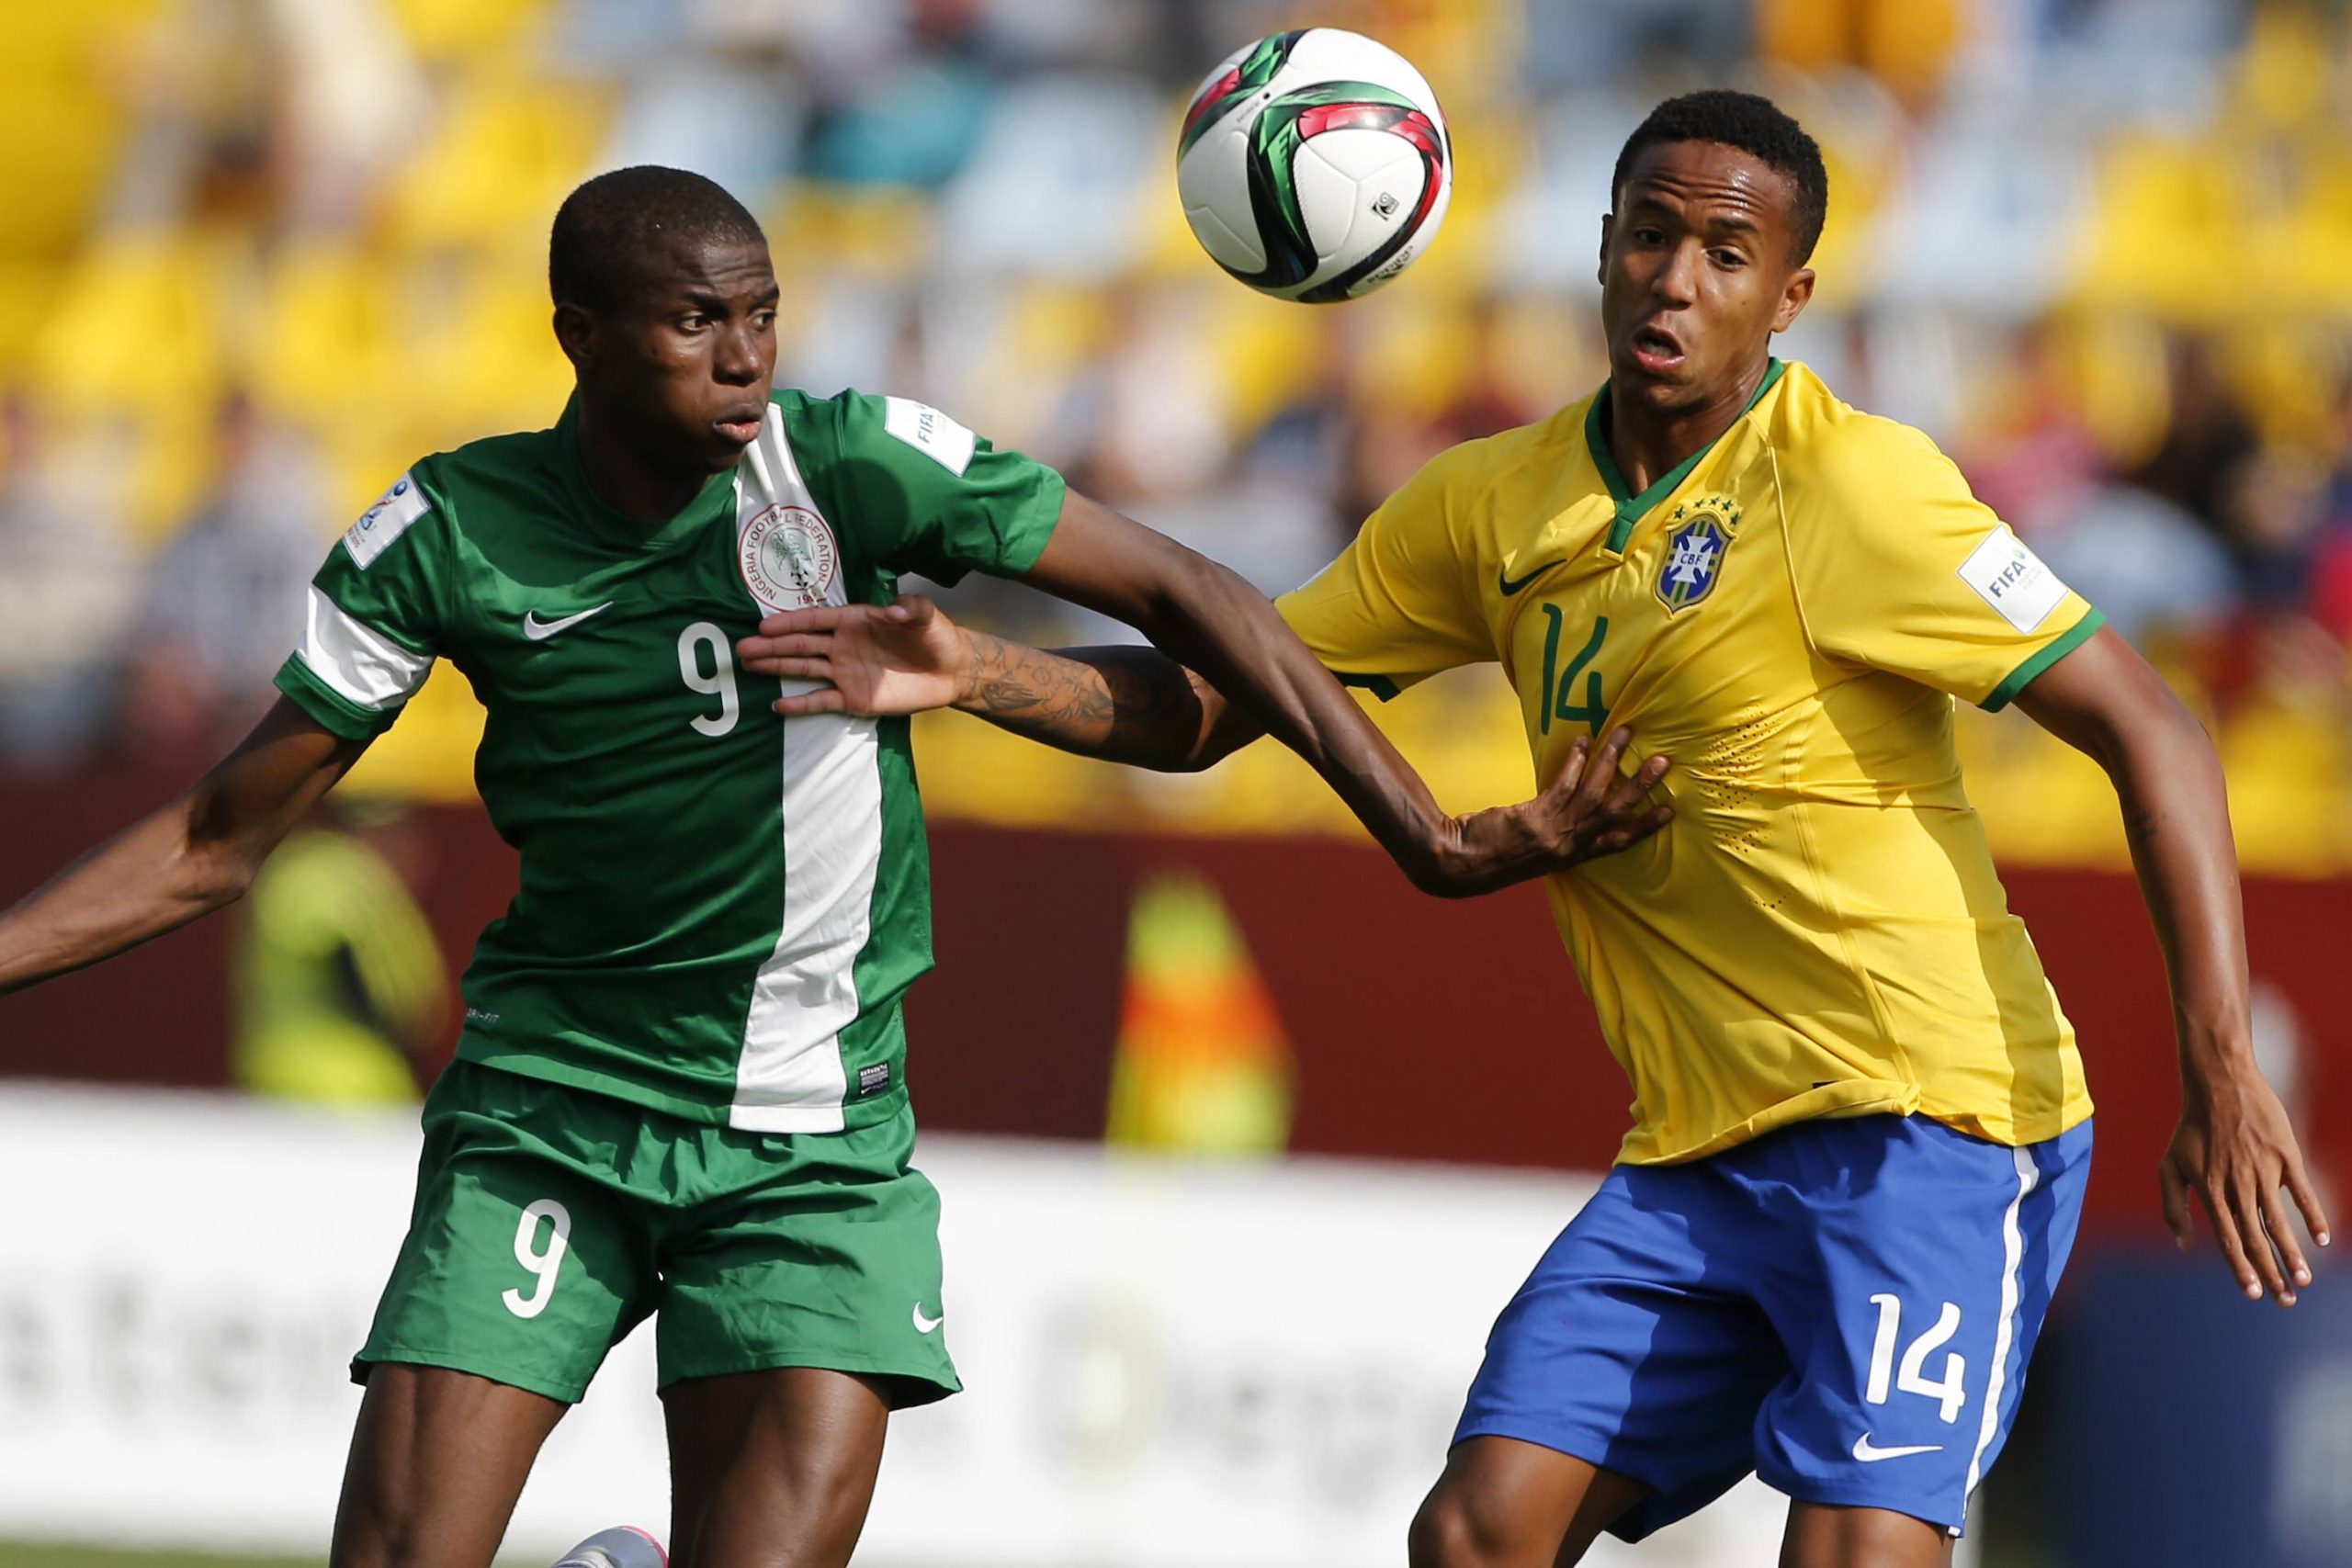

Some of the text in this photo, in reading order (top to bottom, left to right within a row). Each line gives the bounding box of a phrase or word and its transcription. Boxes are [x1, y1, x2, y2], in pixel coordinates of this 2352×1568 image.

[918, 412, 934, 445] FIFA
[747, 511, 793, 549] FOOTBL
[745, 551, 777, 601] NIGERIA
[1680, 552, 1703, 566] CBF
[1988, 559, 2027, 599] FIFA
[677, 621, 740, 738] 9
[1541, 602, 1611, 739] 14
[502, 1198, 571, 1319] 9
[1865, 1292, 1966, 1425] 14
